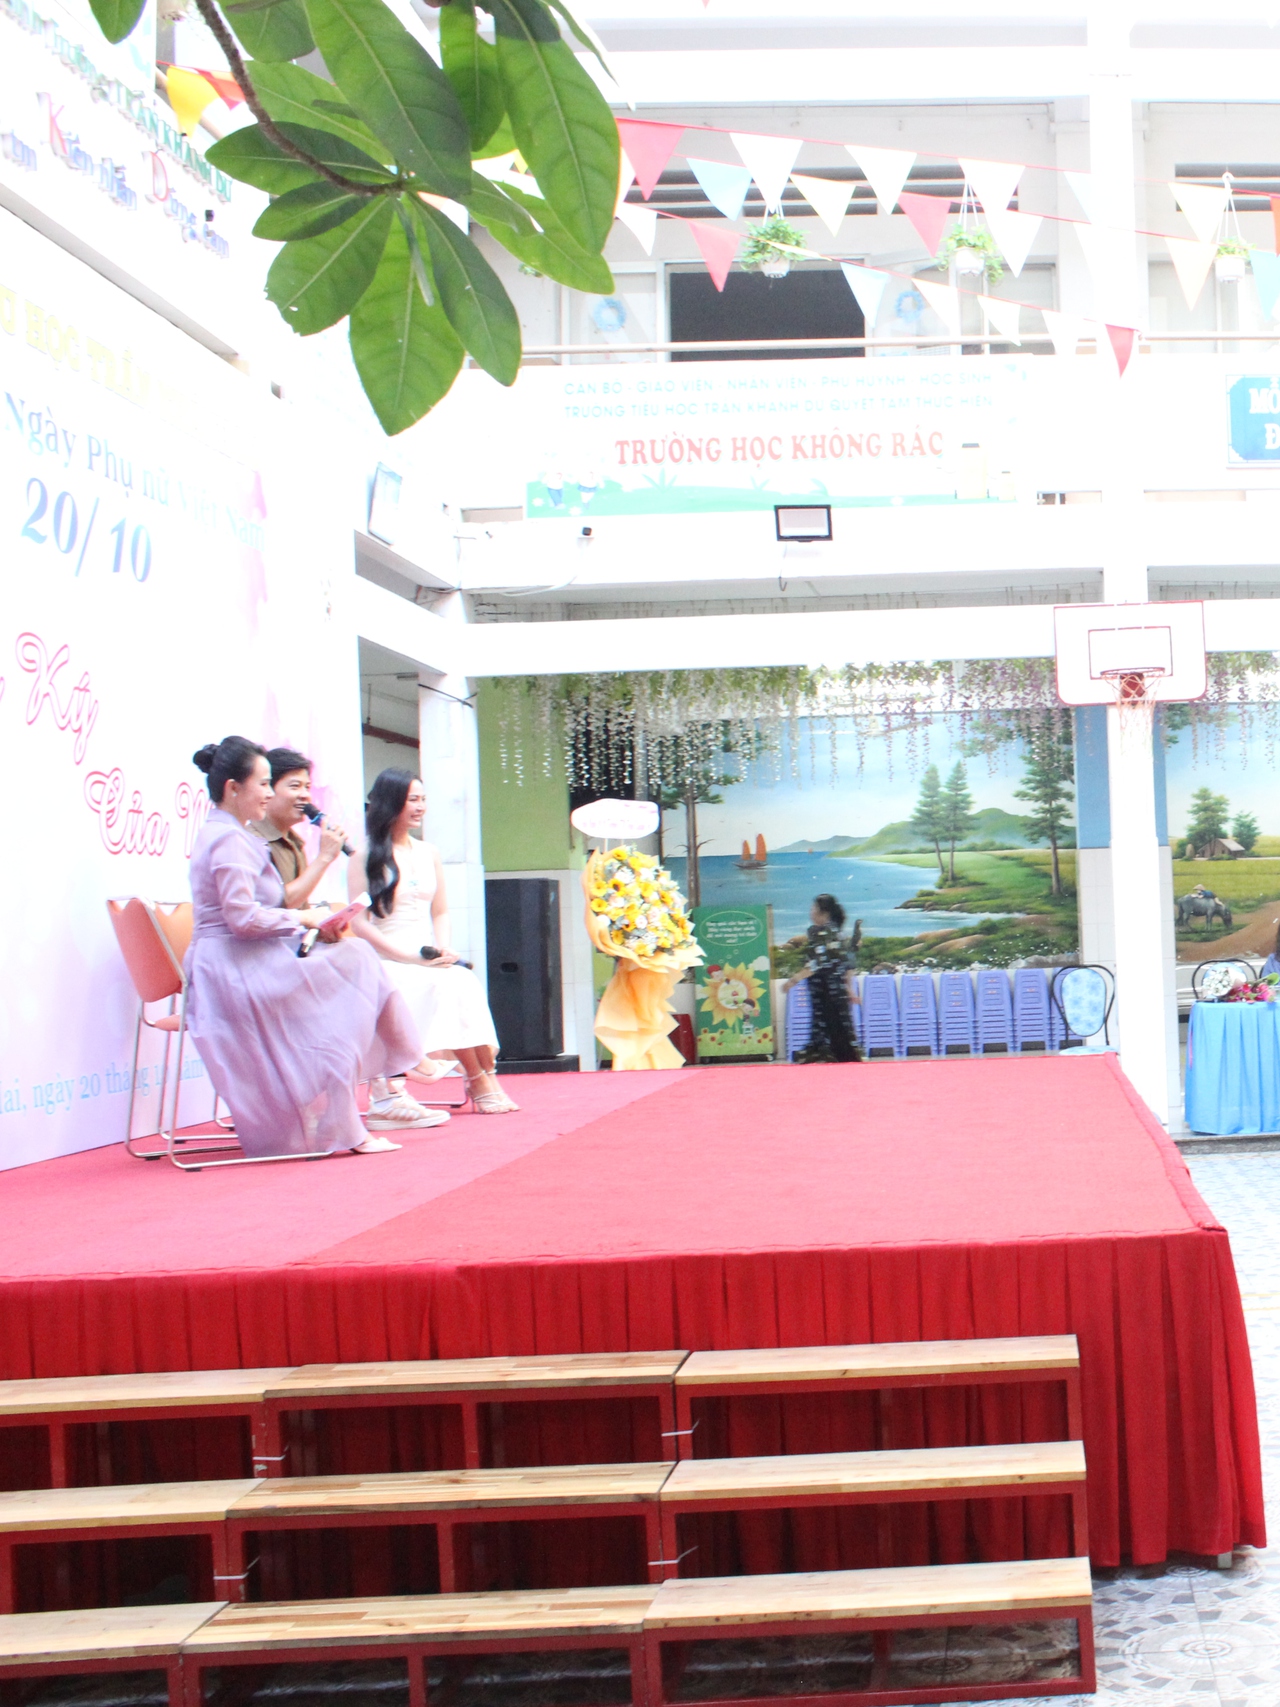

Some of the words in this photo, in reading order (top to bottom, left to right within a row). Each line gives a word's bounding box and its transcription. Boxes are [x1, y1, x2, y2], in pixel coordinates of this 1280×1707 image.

[24, 298, 81, 372] HỌC
[3, 390, 77, 469] Ngày
[87, 433, 133, 499] Phụ
[225, 504, 265, 553] Nam
[615, 431, 723, 467] TRƯỜNG
[731, 436, 783, 469] HỌC
[791, 426, 883, 461] KHÔNG
[891, 424, 944, 459] RÁC
[15, 631, 99, 766] Ký
[84, 766, 170, 858] Của
[32, 1072, 75, 1115] ngày
[80, 1073, 101, 1099] 20
